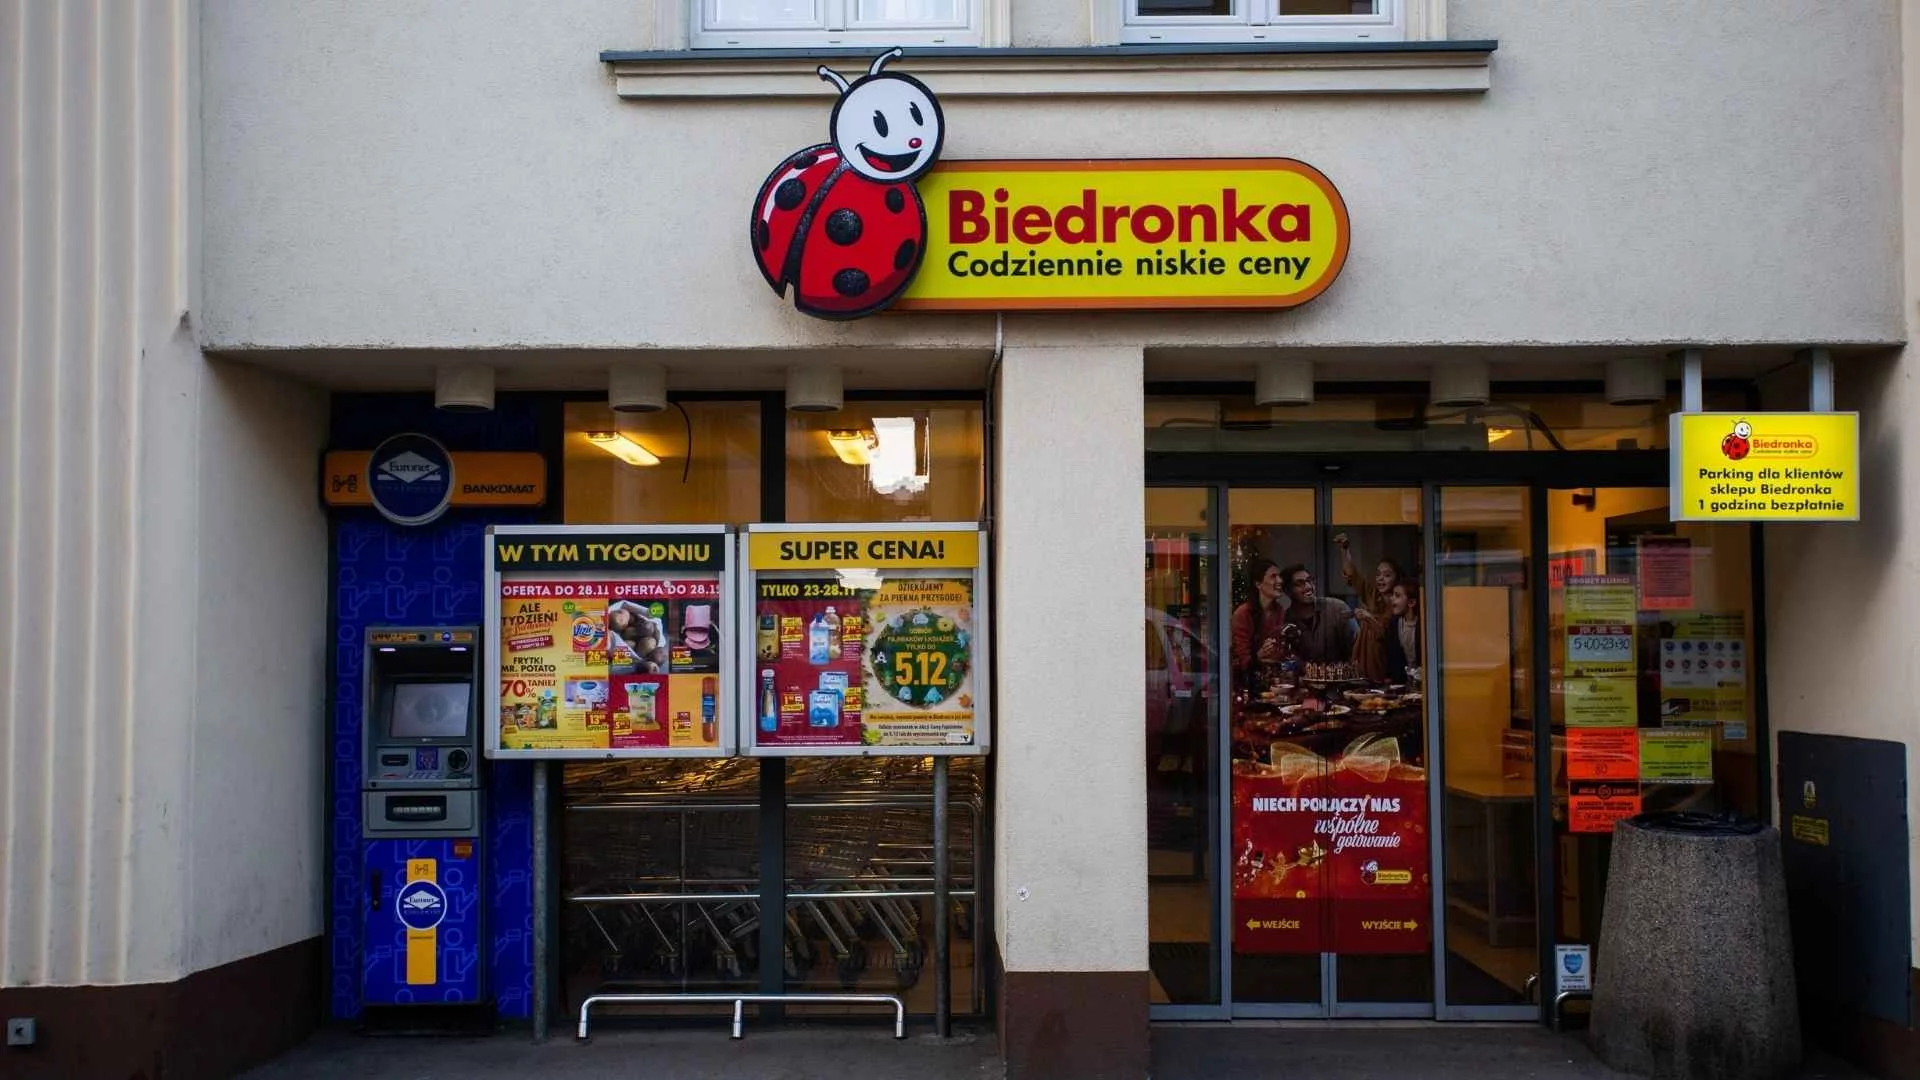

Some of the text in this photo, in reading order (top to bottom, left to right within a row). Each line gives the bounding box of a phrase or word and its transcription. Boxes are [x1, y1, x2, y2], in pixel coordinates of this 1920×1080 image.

[948, 188, 1311, 244] Biedronka
[947, 249, 1311, 281] Codziennie niskie ceny
[1752, 439, 1813, 449] Biedronka
[1699, 468, 1843, 481] Parking dla klientów
[463, 484, 536, 494] BANKOMAT
[1710, 483, 1832, 496] sklepu Biedronka
[1698, 499, 1844, 512] 1 godzina bezpłatnie
[499, 543, 710, 562] W TYM TYGODNIU
[780, 540, 944, 561] SUPER CENA!
[503, 584, 609, 596] OFERTA DO 28.11
[615, 584, 663, 596] OFERTA
[667, 584, 686, 595] DO
[761, 584, 799, 597] TYLKO
[519, 603, 541, 613] ALE
[502, 609, 558, 625] TYDZIEŃ!
[513, 656, 543, 665] FRYTKI
[501, 664, 556, 673] MR. POTATO
[896, 652, 948, 686] 5.12
[1252, 797, 1400, 816] NIECH POŁĄCZY NAS
[1313, 811, 1380, 841] wspólne
[1333, 831, 1401, 854] gotowanie
[1262, 918, 1301, 929] WEJŚCIE
[1361, 918, 1402, 930] WYJŚCIE
